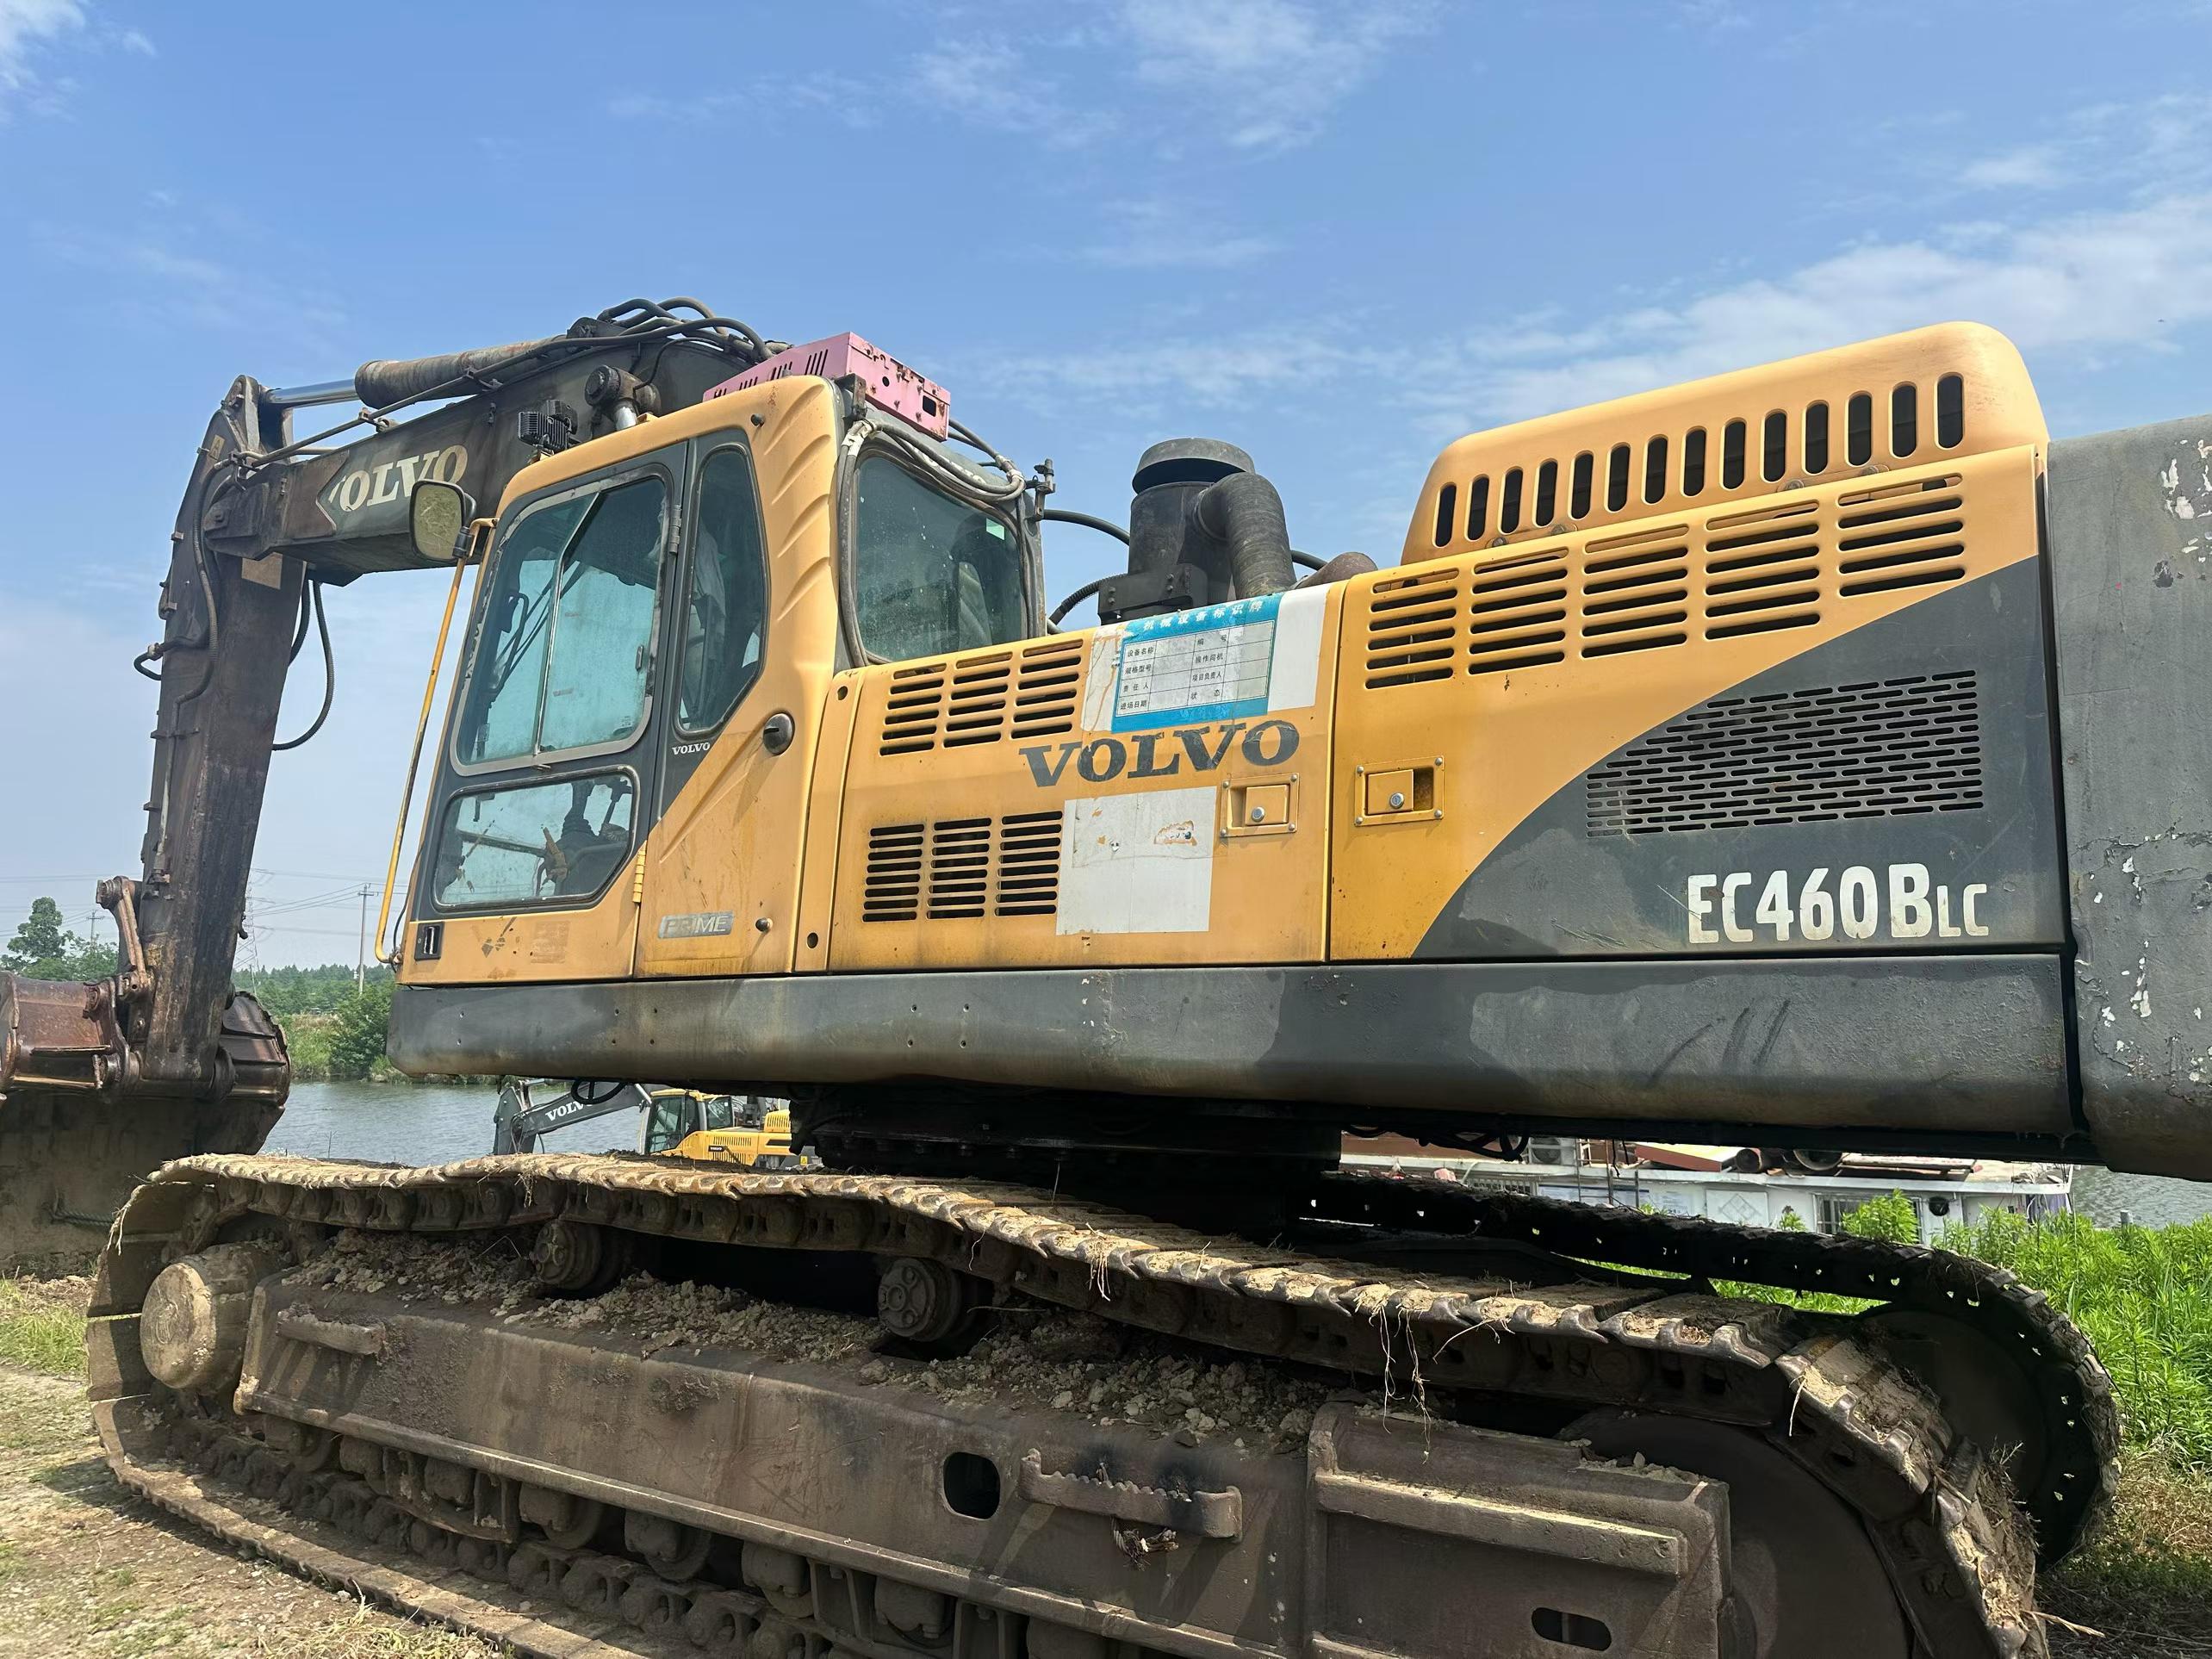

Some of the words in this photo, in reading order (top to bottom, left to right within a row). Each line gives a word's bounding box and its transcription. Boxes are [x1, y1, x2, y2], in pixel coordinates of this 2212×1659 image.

[1127, 646, 1154, 658] 设备名称
[1124, 663, 1152, 674] 规格型号
[1192, 672, 1221, 682] 项目负责人
[672, 742, 711, 755] VOLVO
[1018, 720, 1300, 787] VOLVO
[545, 1101, 593, 1121] VOLV
